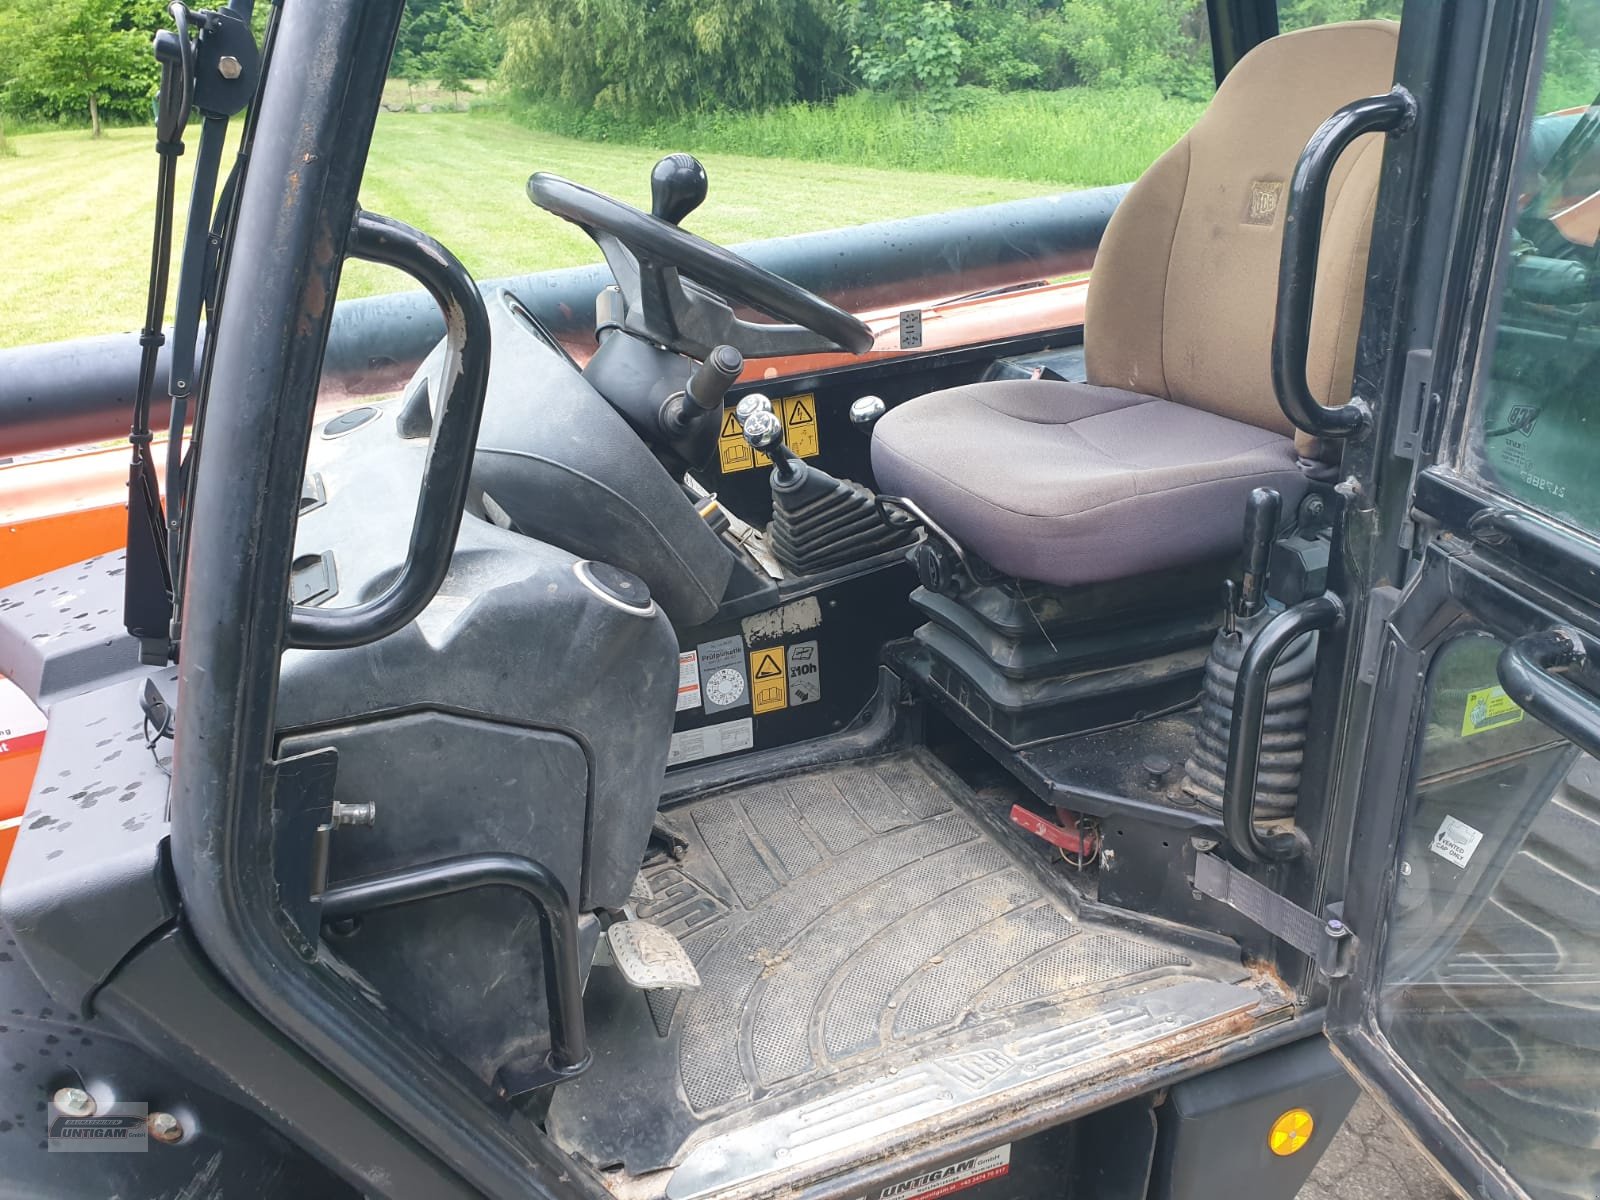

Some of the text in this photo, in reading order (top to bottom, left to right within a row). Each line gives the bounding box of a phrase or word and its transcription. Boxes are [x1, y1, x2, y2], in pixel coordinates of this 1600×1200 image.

[1435, 842, 1464, 860] CAP ONLY
[1442, 839, 1465, 854] VENTED
[977, 1154, 1000, 1166] GmbH
